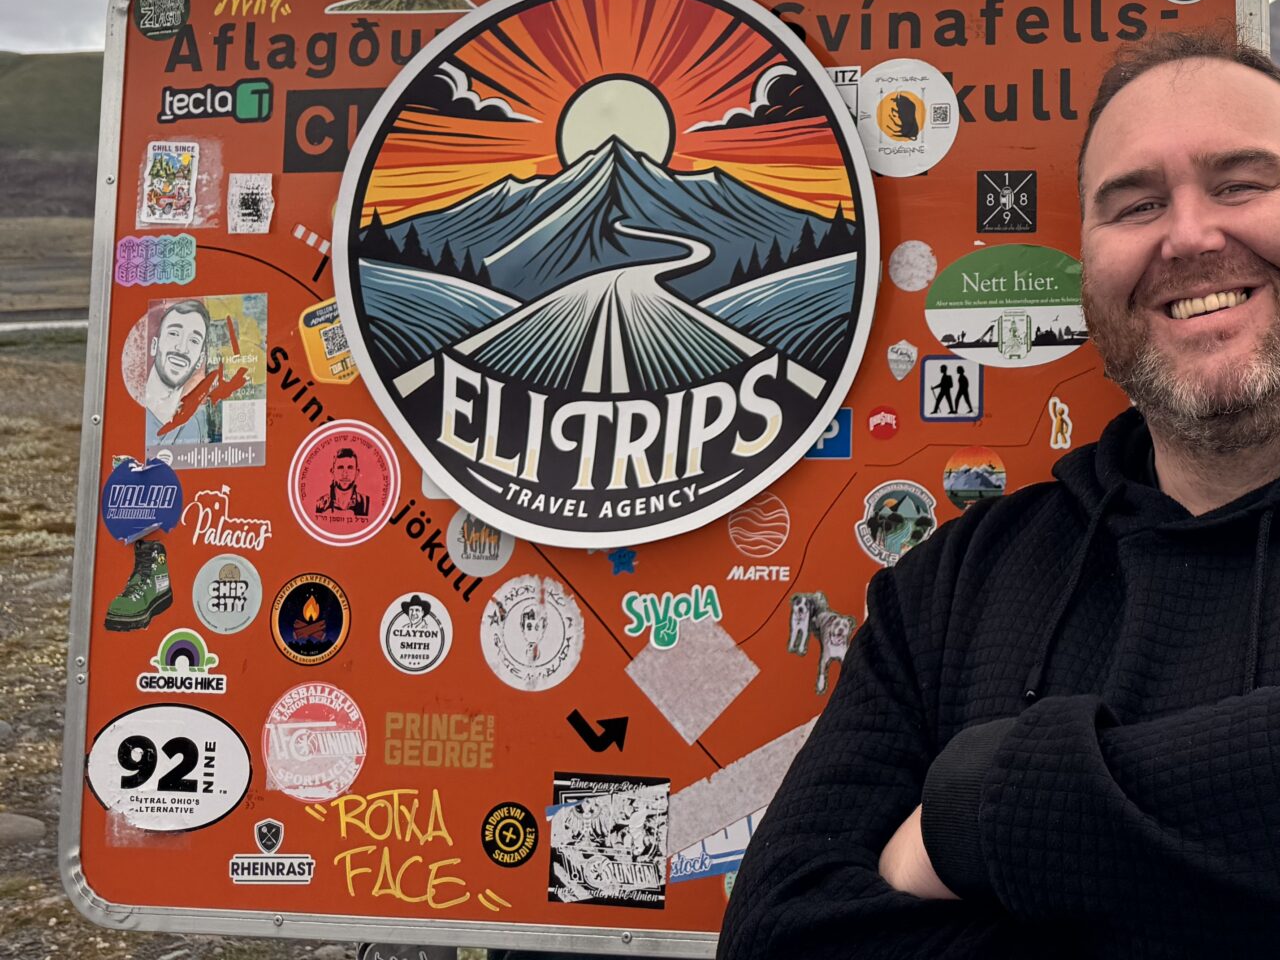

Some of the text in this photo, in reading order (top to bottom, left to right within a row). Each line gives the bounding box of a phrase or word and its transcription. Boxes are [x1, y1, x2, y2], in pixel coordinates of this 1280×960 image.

[165, 17, 449, 79] Aflagðu
[833, 70, 858, 83] ITZ
[161, 88, 233, 120] tecla
[941, 68, 1078, 123] kull
[152, 144, 196, 153] CHILL SINCE
[1003, 172, 1009, 186] 1
[986, 193, 1028, 206] 8 8
[1002, 211, 1011, 225] 9
[961, 270, 1059, 293] Nett hier.
[437, 352, 784, 491] ELITRIPS
[503, 483, 700, 520] TRAVEL AGENCY
[181, 501, 272, 551] Palacios
[726, 565, 790, 581] MARTE
[274, 580, 298, 611] COMFORT
[300, 575, 331, 586] CAMPERS
[393, 629, 438, 638] CLAYTON
[400, 642, 430, 650] SMITH
[139, 675, 224, 691] GEOBUG HIKE
[273, 685, 360, 722] FUSSBALLCLUB
[281, 695, 342, 721] UNION BERLIN
[385, 712, 485, 741] PRINCE
[117, 735, 199, 792] 92
[202, 741, 216, 793] NINE
[384, 739, 494, 768] GEORGE
[620, 781, 649, 792] Regio
[170, 797, 200, 806] OHIO'S
[485, 806, 526, 841] MA DOVE VAI
[492, 849, 521, 863] SENZA
[671, 852, 711, 877] stock
[230, 861, 314, 876] RHEINRAST
